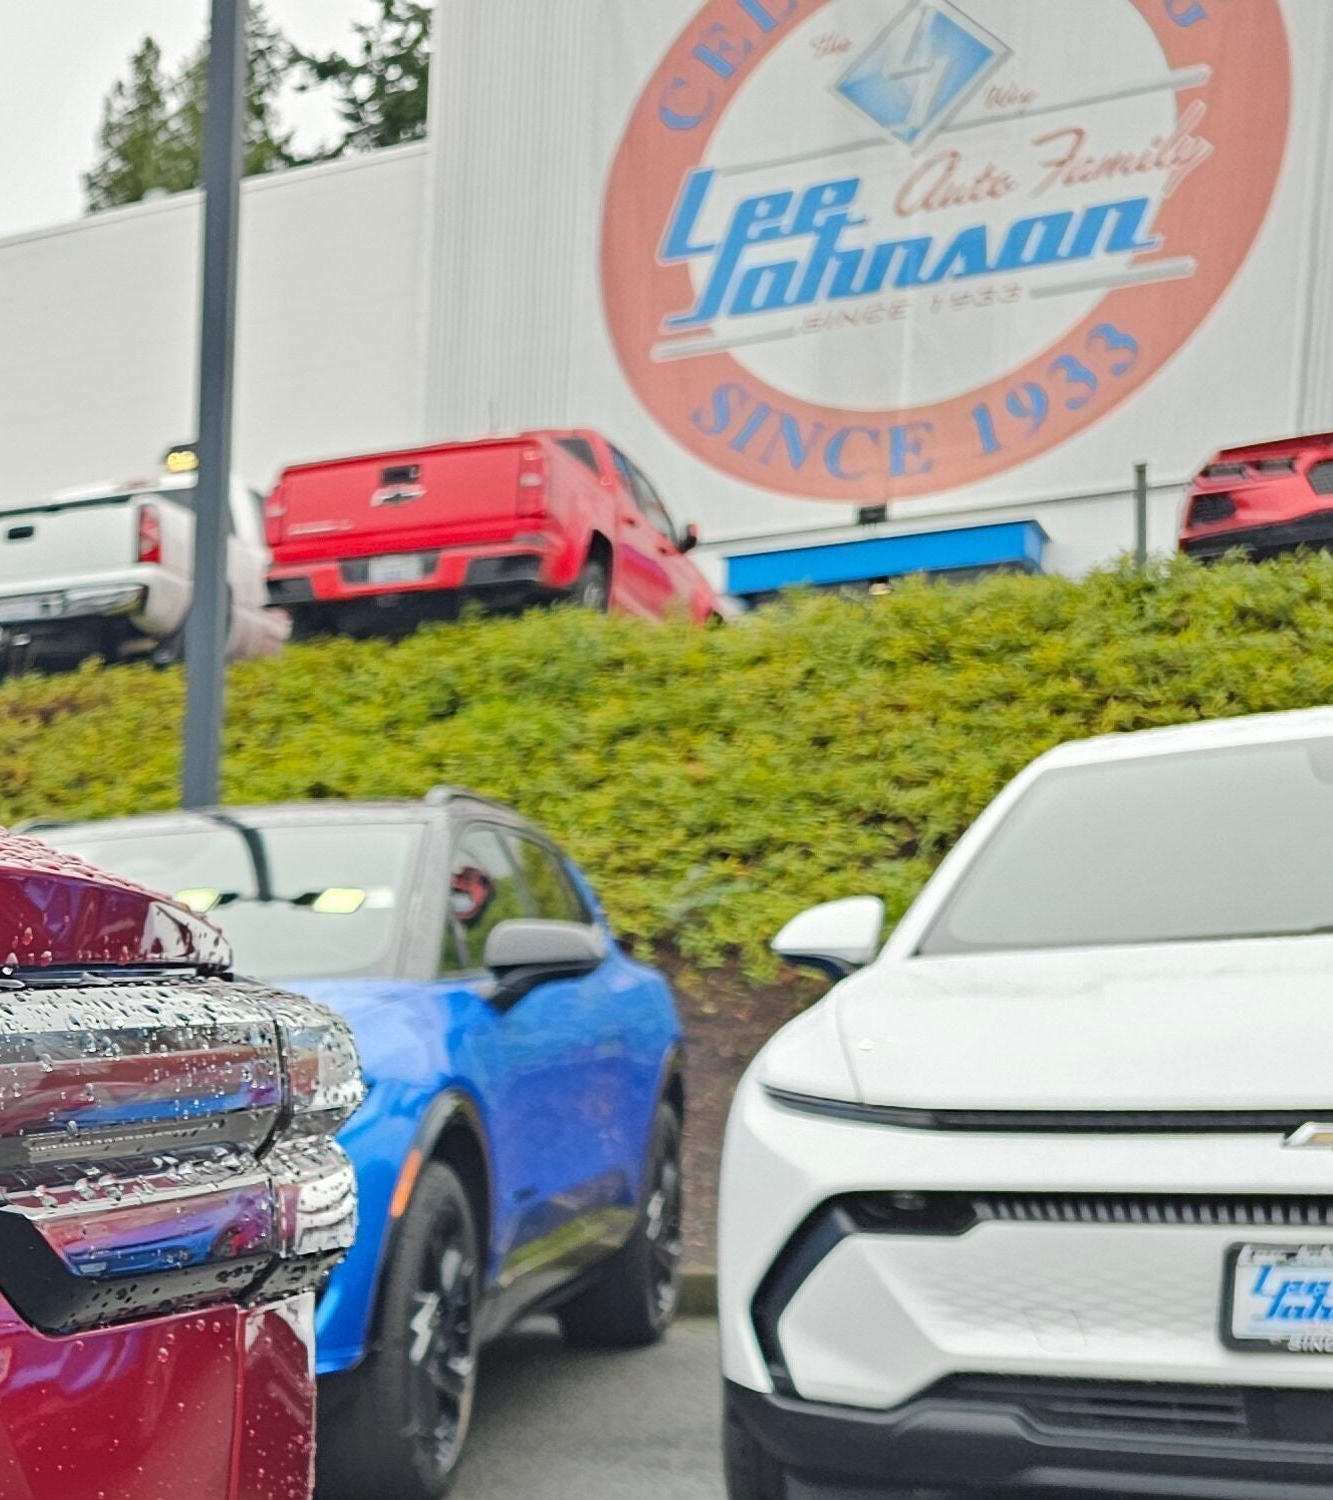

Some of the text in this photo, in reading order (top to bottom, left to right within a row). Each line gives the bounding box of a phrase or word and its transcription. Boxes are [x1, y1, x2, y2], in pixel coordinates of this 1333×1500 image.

[659, 166, 863, 262] Lee
[893, 97, 1214, 218] Auto Family
[665, 195, 1162, 330] Johnson
[797, 299, 913, 335] SINCE
[691, 322, 1139, 481] SINCE 1933
